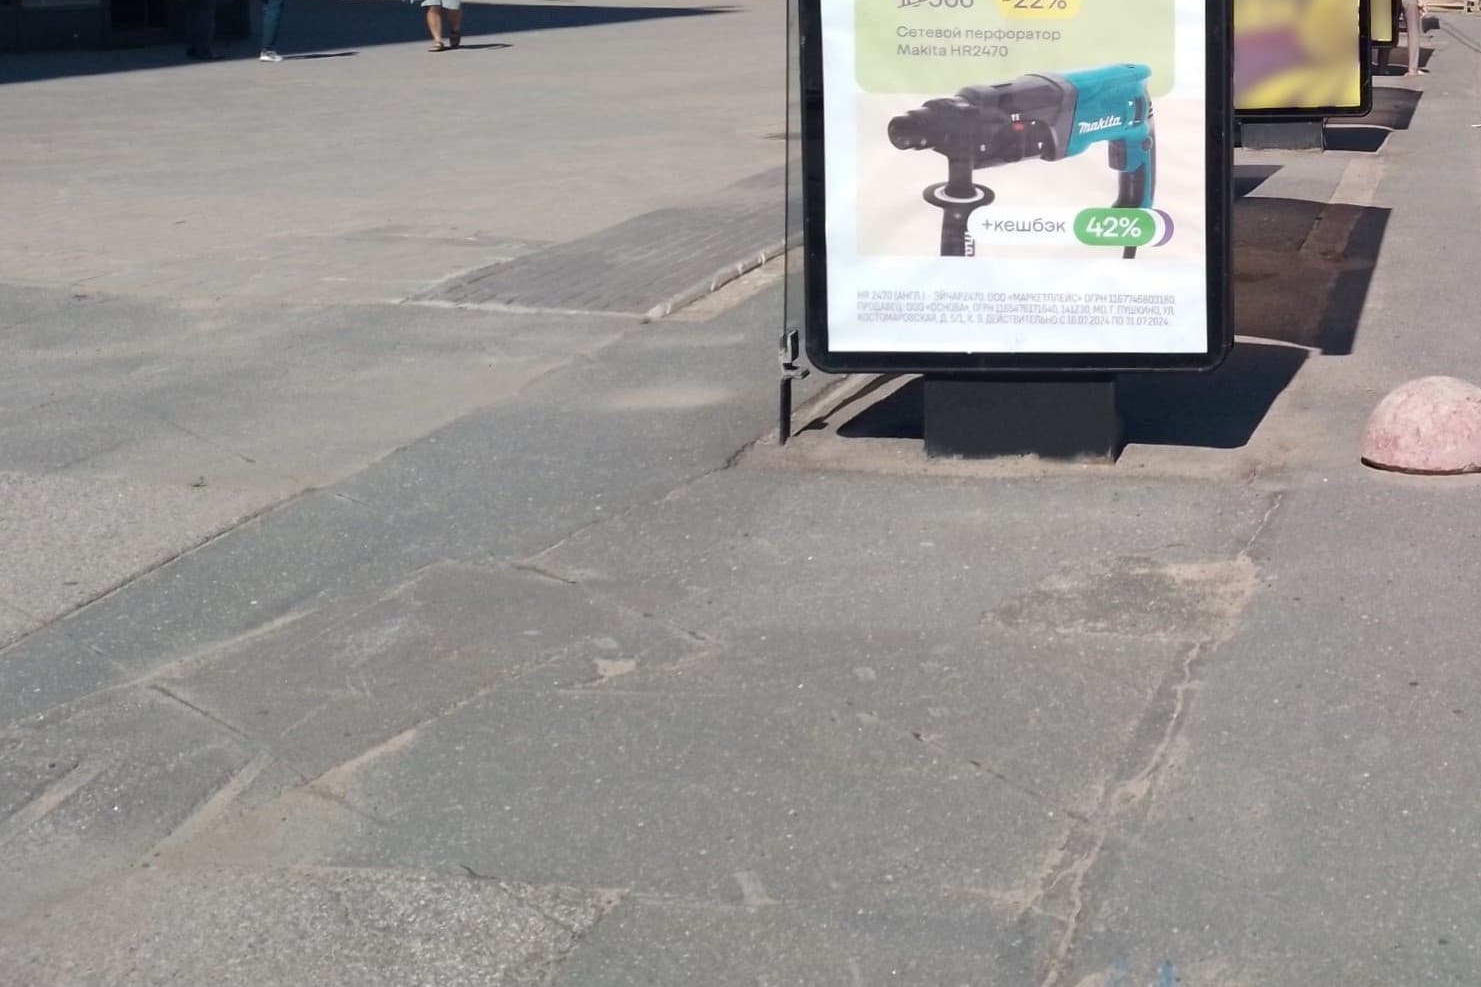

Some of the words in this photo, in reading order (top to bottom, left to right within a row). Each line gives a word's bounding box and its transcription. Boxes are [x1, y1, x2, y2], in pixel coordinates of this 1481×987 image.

[896, 24, 962, 40] Сетевой
[965, 27, 1062, 43] перфоратор
[896, 43, 947, 57] Makita
[950, 44, 1009, 58] HR2470
[981, 216, 1066, 234] +кешбэк
[1085, 216, 1143, 238] 42%
